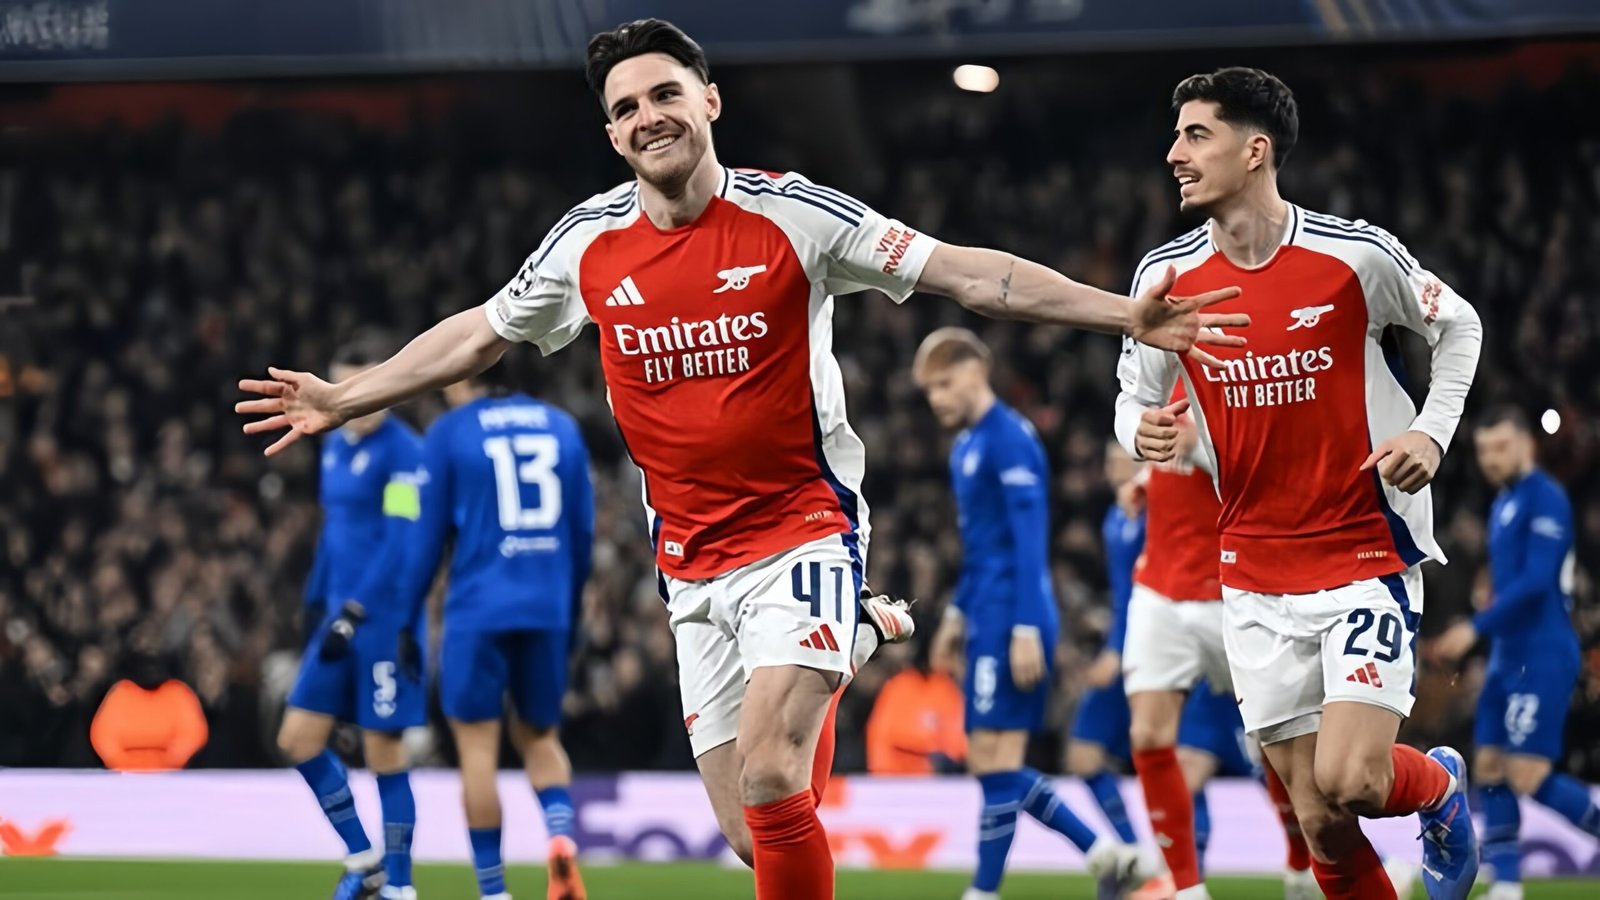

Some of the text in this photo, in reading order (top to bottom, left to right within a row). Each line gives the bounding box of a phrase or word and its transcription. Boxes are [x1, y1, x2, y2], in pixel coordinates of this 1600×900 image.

[882, 230, 917, 275] RWAN
[613, 311, 768, 355] Emirates
[644, 346, 750, 383] FLY BETTER
[1223, 377, 1316, 408] FLY BETTER
[482, 433, 563, 531] 13
[791, 561, 844, 624] 41
[1343, 608, 1403, 663] 29
[372, 660, 397, 701] 5
